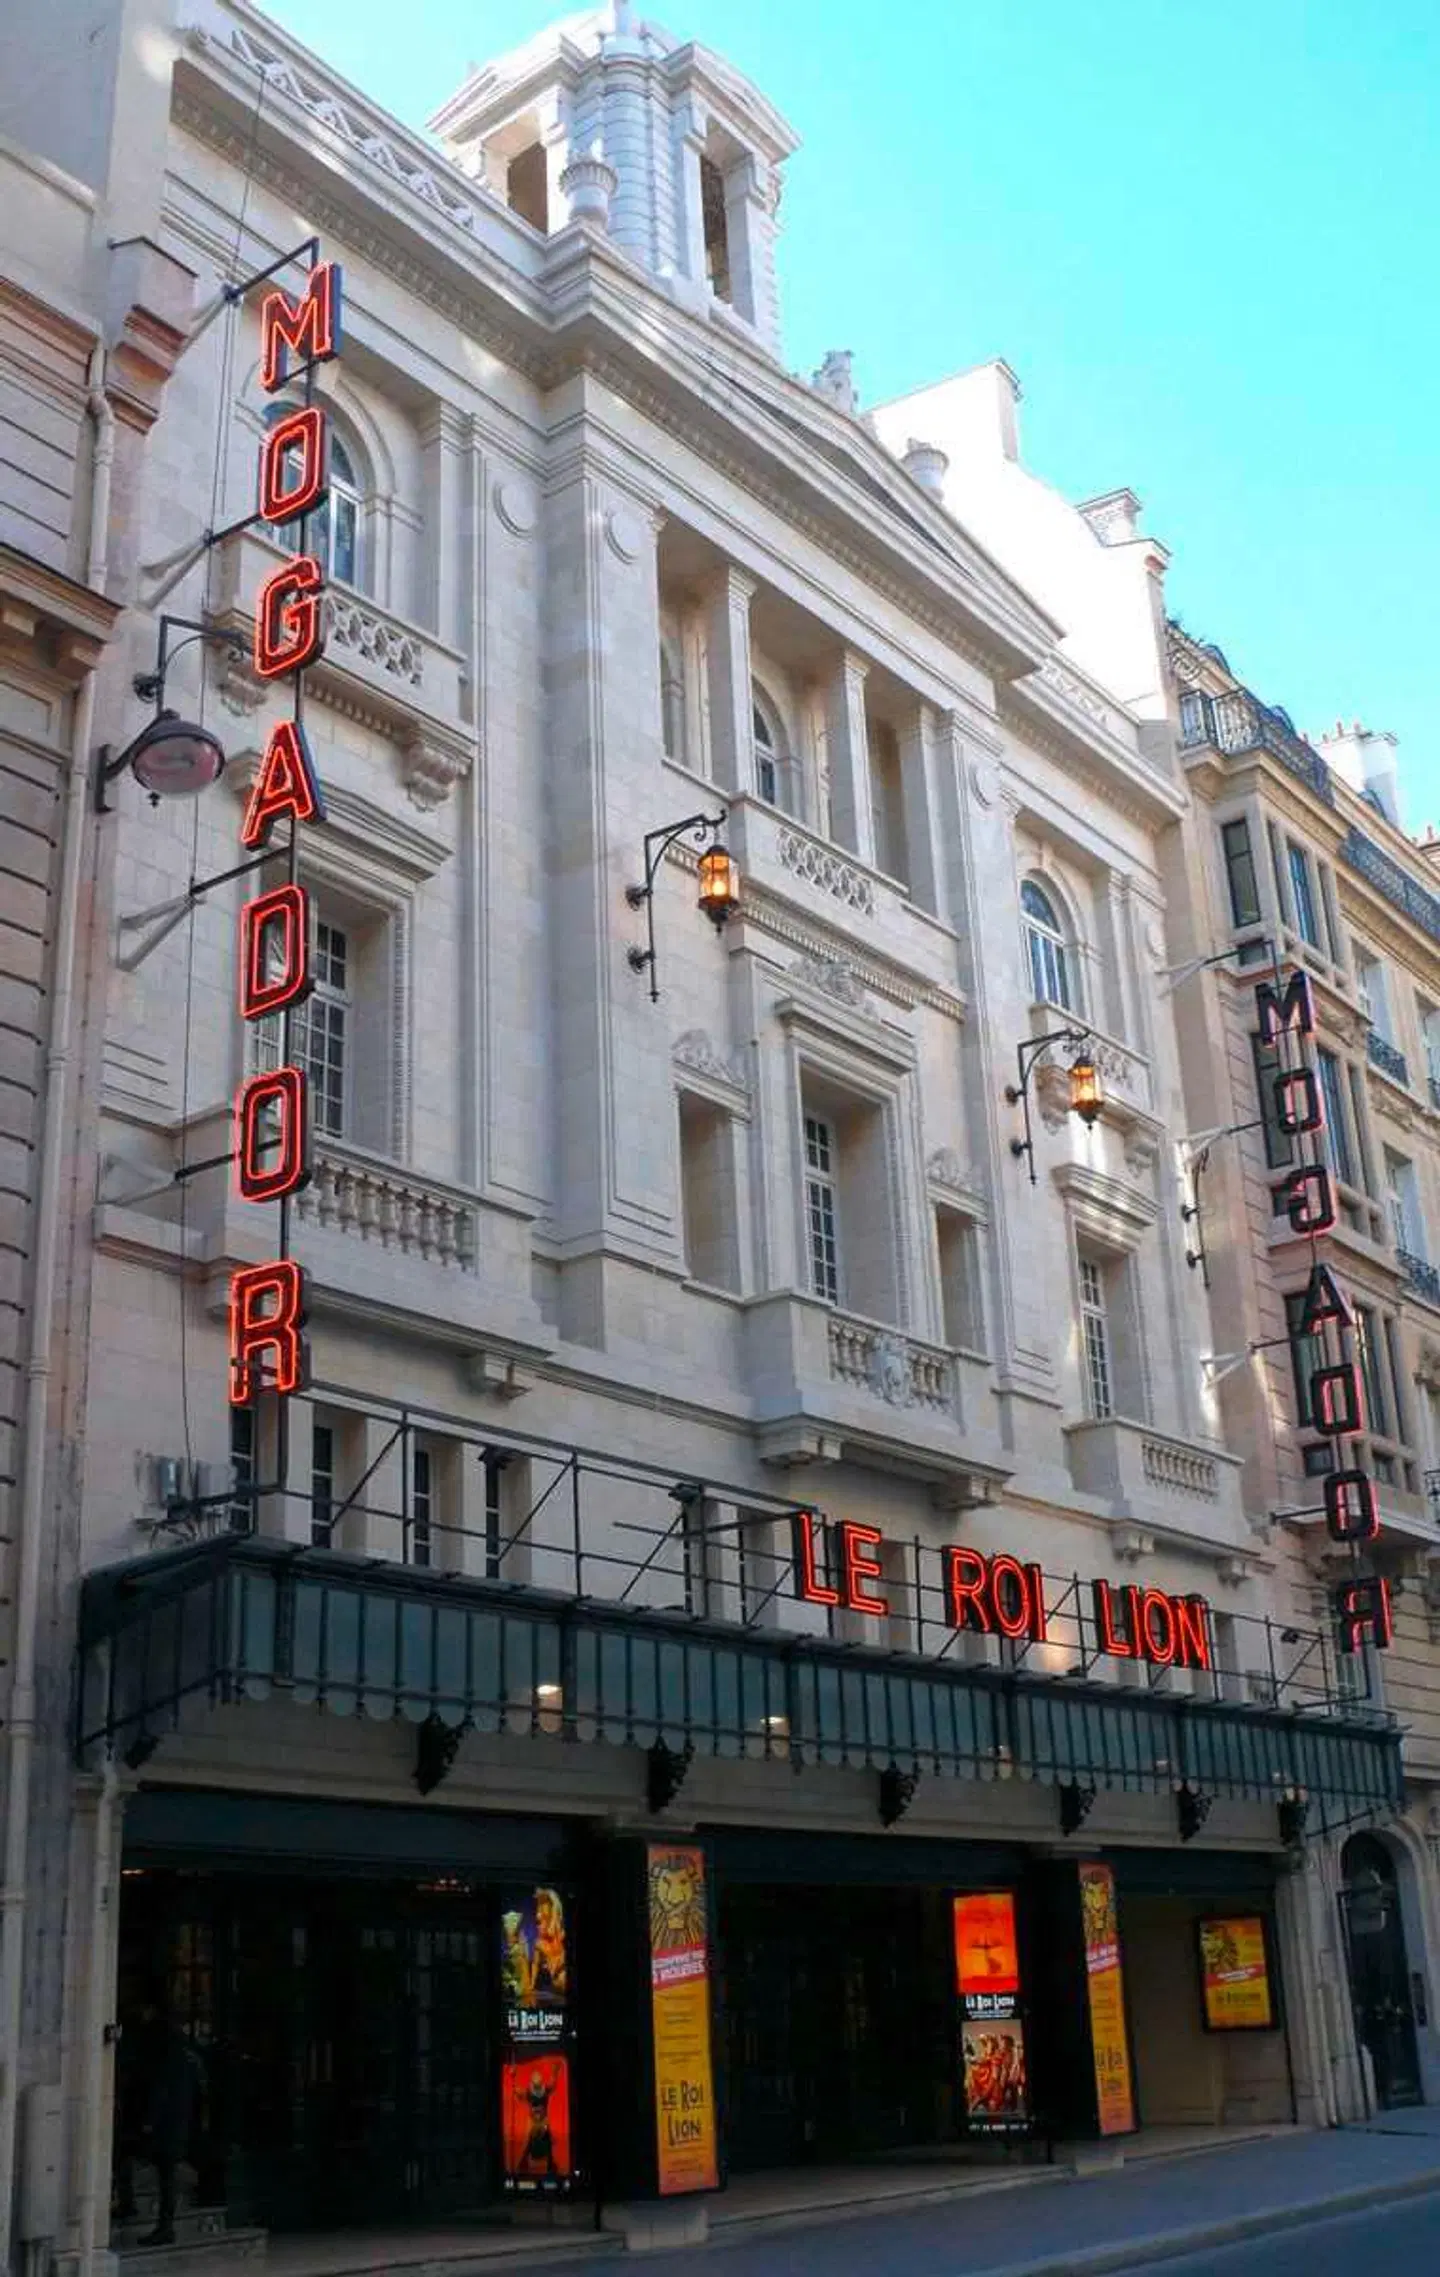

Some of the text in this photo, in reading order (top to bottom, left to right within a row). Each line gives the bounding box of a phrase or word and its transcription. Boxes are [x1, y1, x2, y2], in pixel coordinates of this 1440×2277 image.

[229, 259, 341, 1406] MOGADOR
[793, 1511, 1211, 1671] LE ROI LION
[661, 2080, 704, 2113] LE ROI
[668, 2113, 702, 2146] LION
